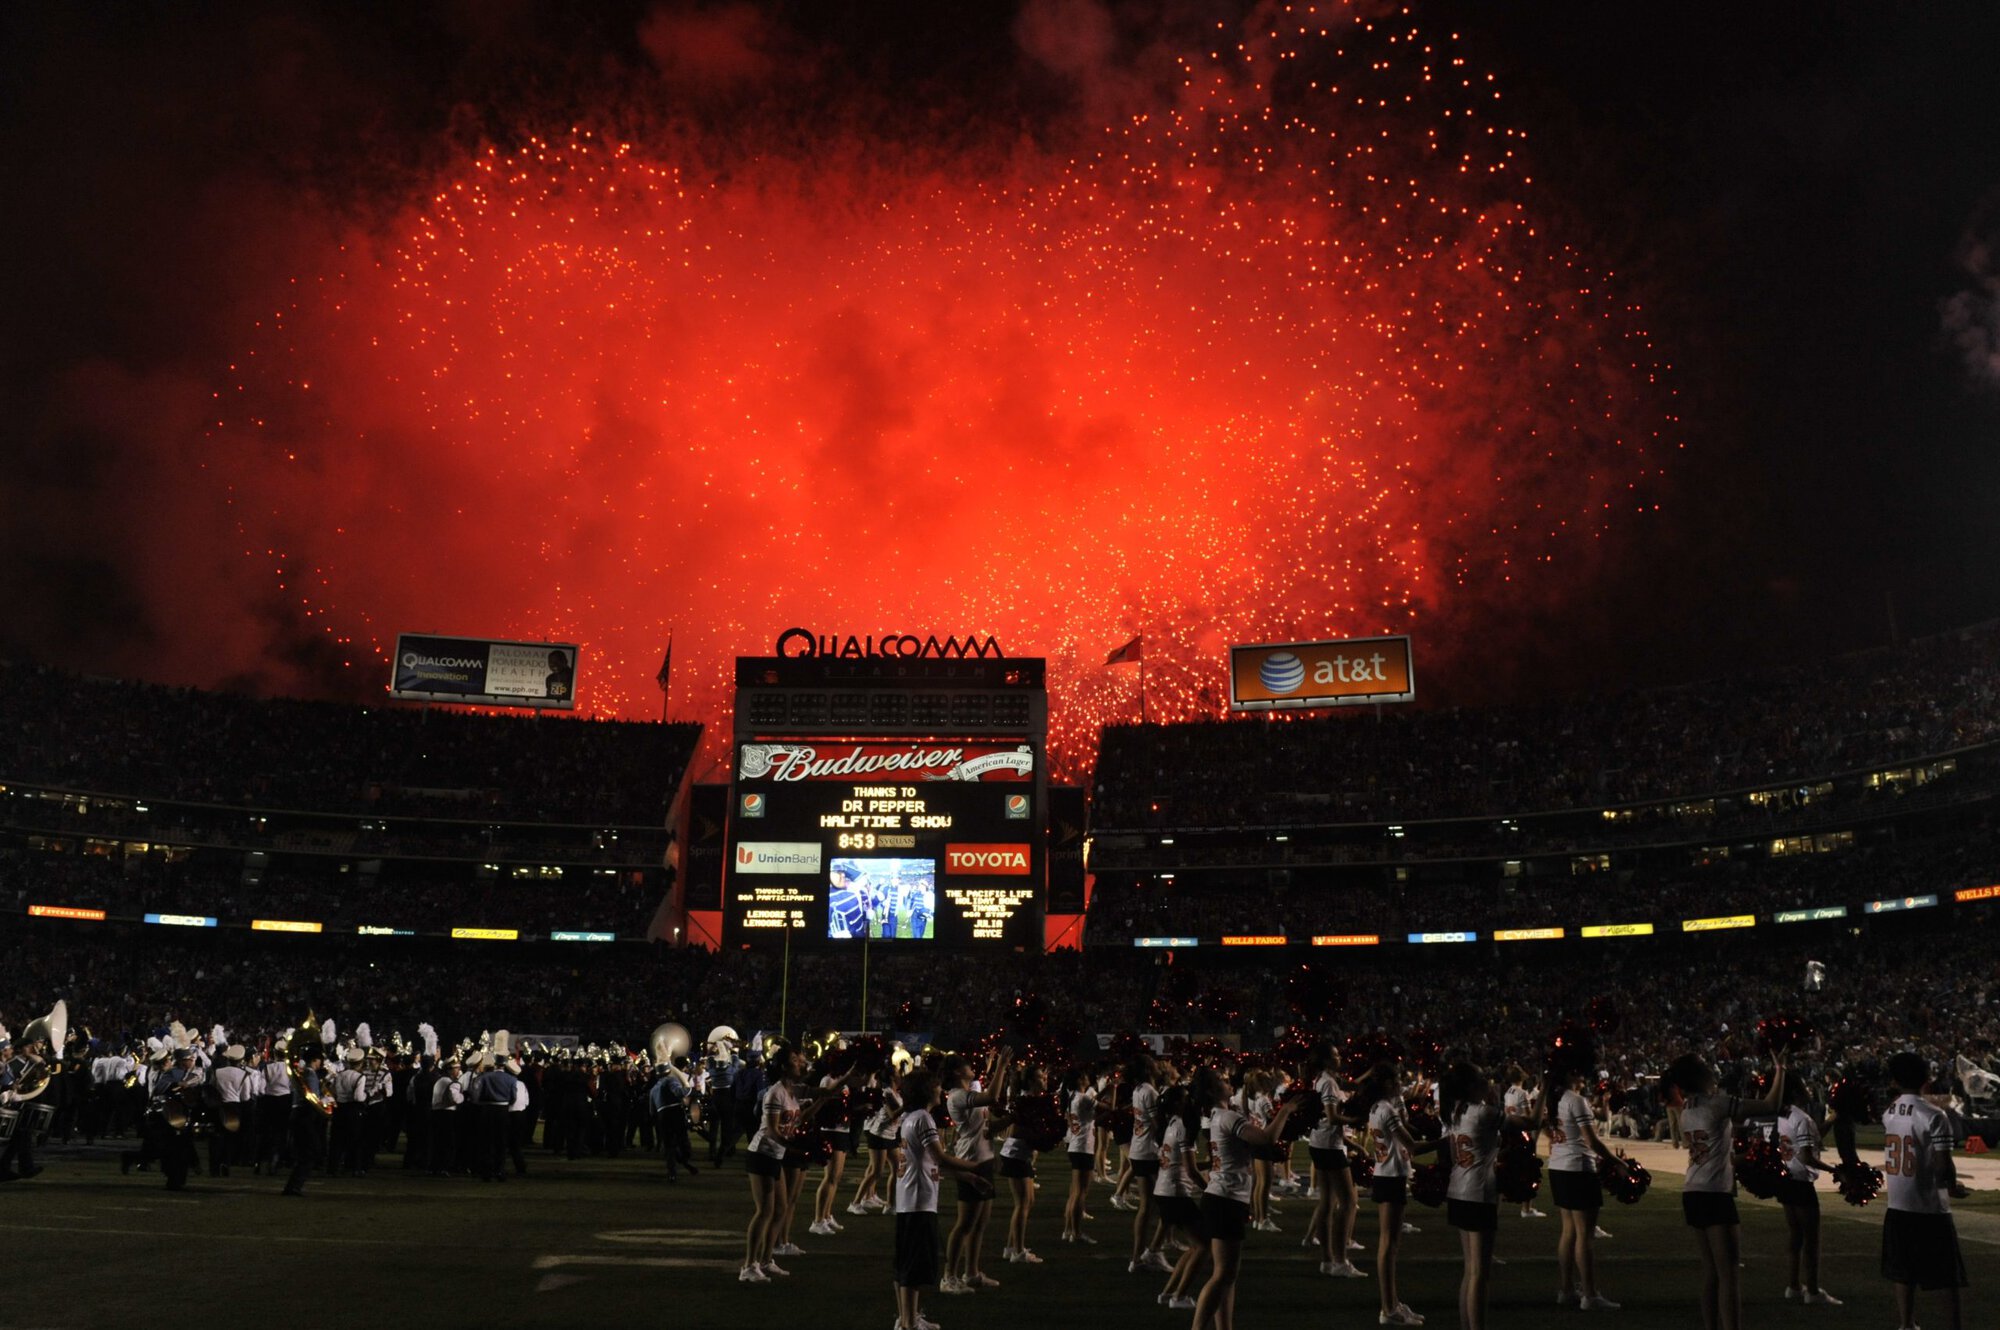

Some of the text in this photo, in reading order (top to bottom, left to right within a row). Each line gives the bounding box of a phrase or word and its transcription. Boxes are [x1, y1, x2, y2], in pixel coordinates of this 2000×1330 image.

[776, 628, 1004, 658] QUALCOMM
[493, 649, 547, 659] PALOMAR
[402, 652, 483, 670] QUALCOMM
[492, 657, 546, 668] POMERADO
[491, 667, 546, 677] HEALTH
[823, 666, 986, 677] STADIUM
[1313, 652, 1387, 684] at&t
[766, 744, 964, 781] Budweiser
[965, 758, 1004, 776] American
[1005, 756, 1031, 767] Lager
[853, 786, 917, 798] THANKS TO
[842, 800, 925, 812] DR PEPPER
[820, 815, 952, 828] HALFTIME SHOW
[838, 833, 876, 849] 8:53
[878, 836, 916, 846] SYCUAN
[758, 853, 819, 864] UnionBank
[950, 852, 1026, 867] TOYOTA
[945, 889, 1034, 898] THE PACIFIC LIFE
[1955, 887, 1992, 901] WELLS
[955, 897, 996, 905] HOLIDAY
[972, 904, 1006, 912] THANKS
[746, 910, 787, 919] LEMOORE
[792, 919, 806, 928] CA
[974, 919, 1004, 928] JULIA
[1422, 932, 1466, 943] GEICO
[1503, 928, 1554, 940] CYMER
[1223, 936, 1287, 945] WELLS FARGO
[1884, 1134, 1917, 1178] 36
